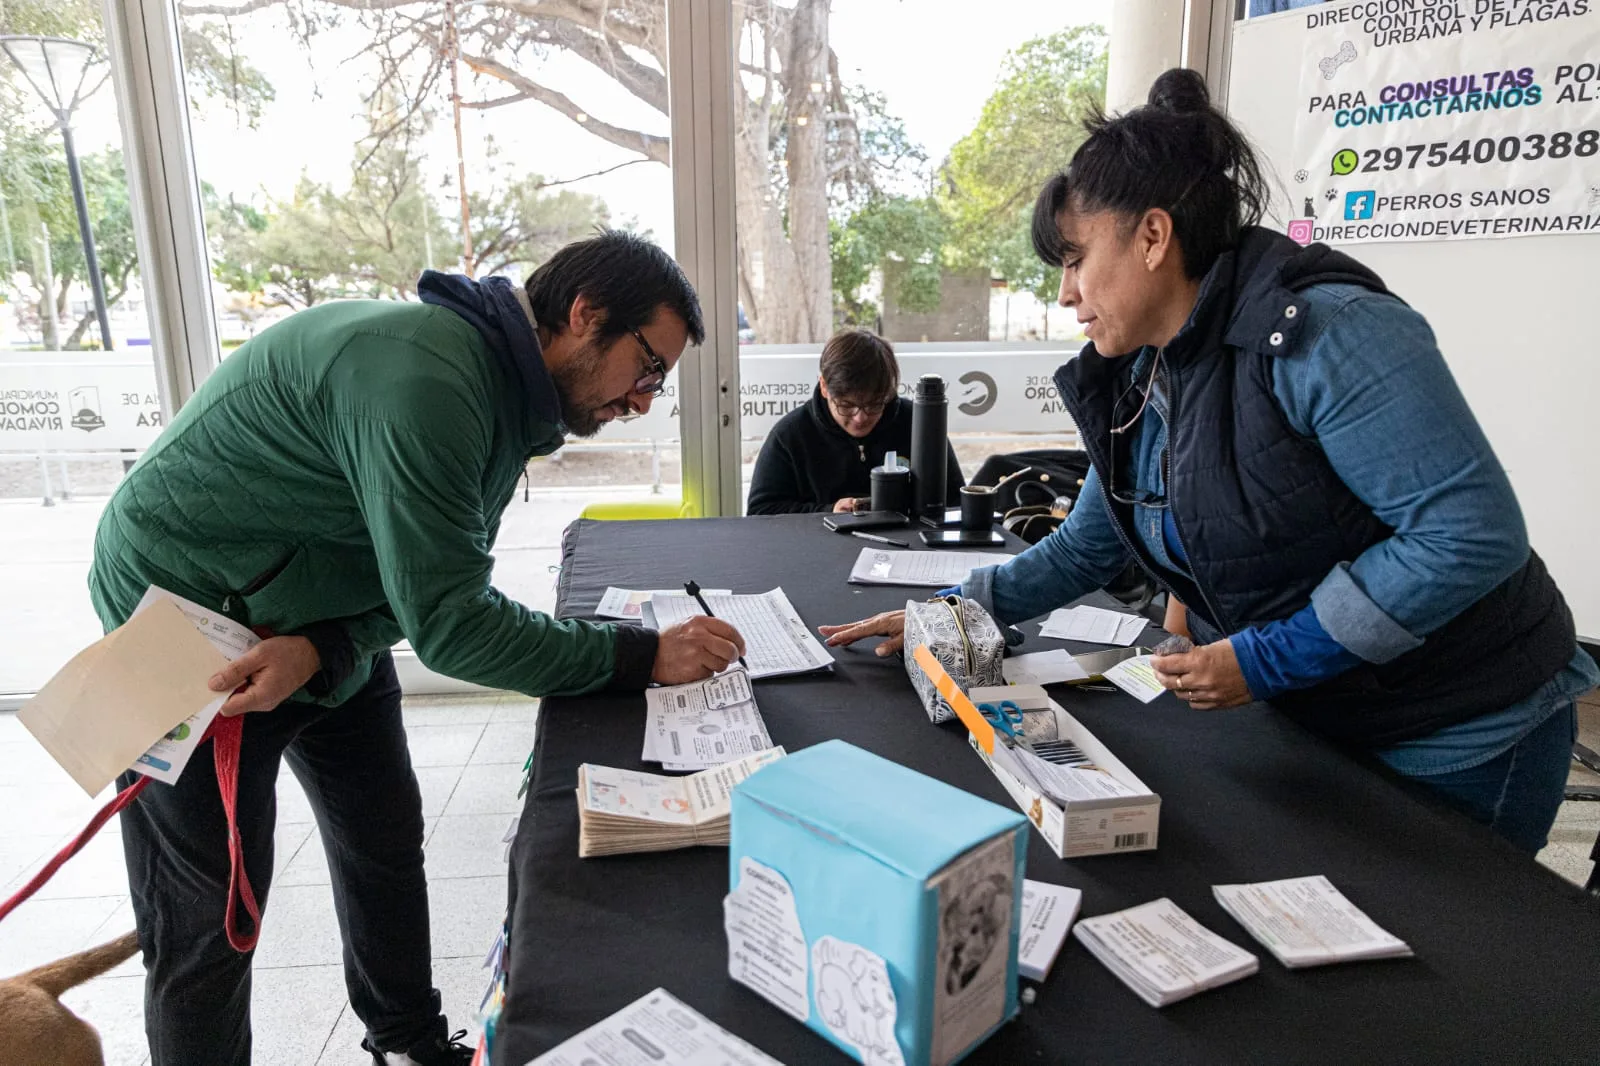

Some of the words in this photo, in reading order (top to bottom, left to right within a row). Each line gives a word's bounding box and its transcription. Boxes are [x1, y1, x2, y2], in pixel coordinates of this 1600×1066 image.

[1363, 3, 1466, 34] CONTROL
[1374, 19, 1463, 47] URBANA
[1470, 15, 1484, 32] Y
[1309, 90, 1367, 113] PARA
[1379, 67, 1534, 105] CONSULTAS
[1555, 63, 1600, 85] PO
[1334, 85, 1543, 128] CONTACTARNOS
[1361, 130, 1600, 172] 2975400388
[1377, 192, 1463, 211] PERROS
[1469, 187, 1551, 207] SANOS
